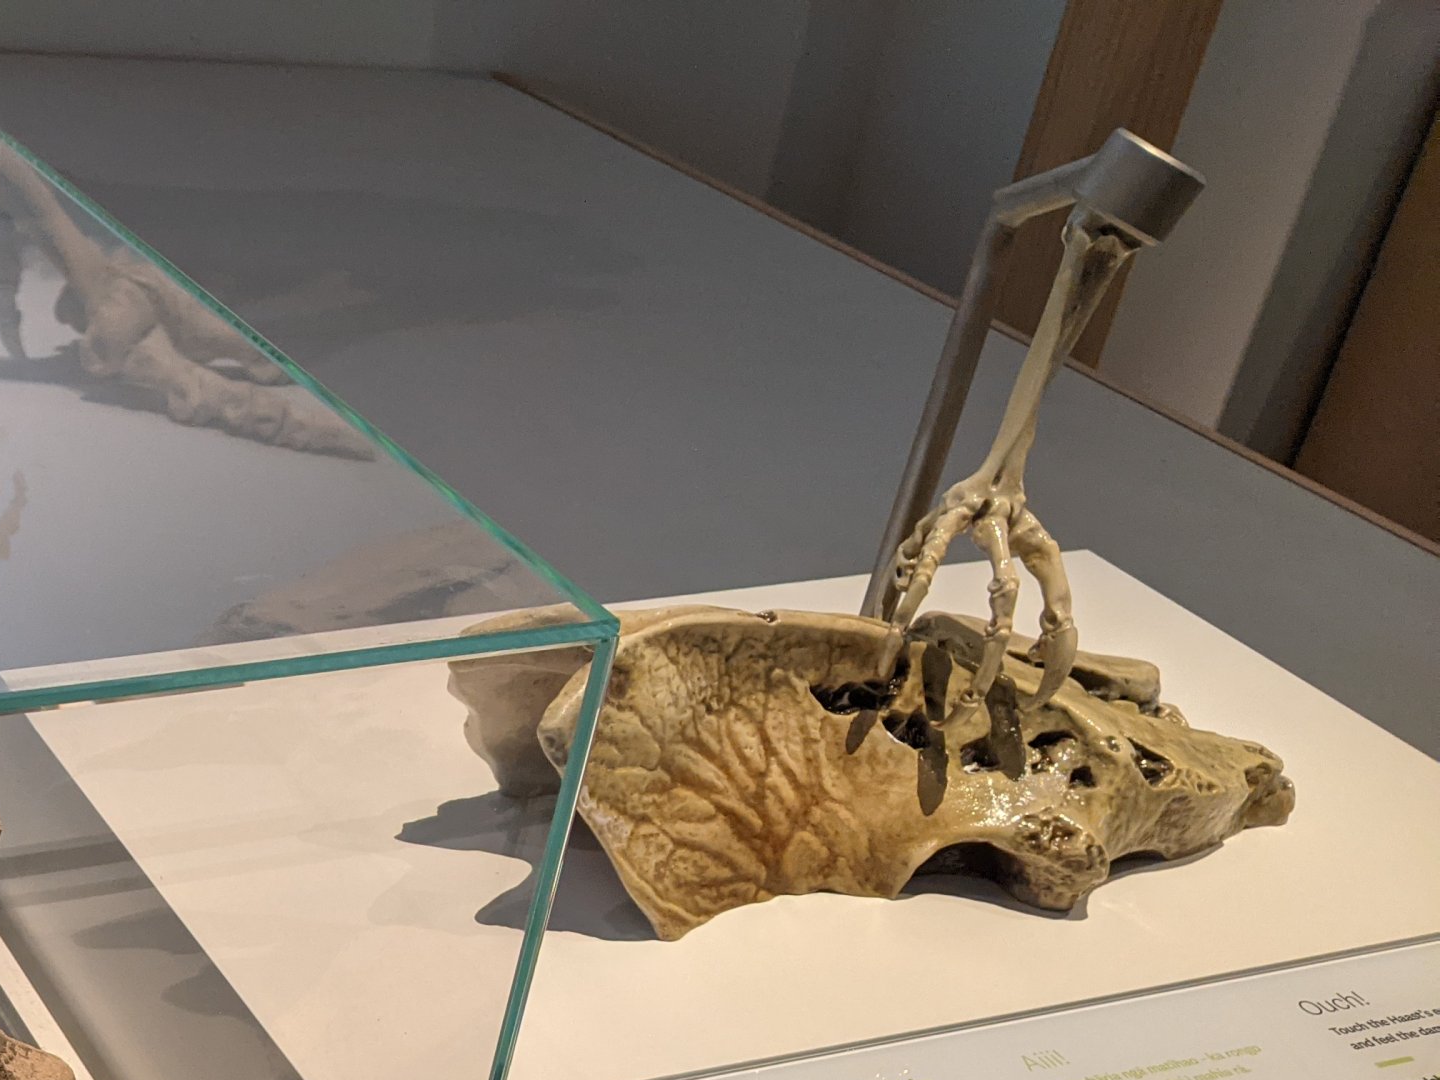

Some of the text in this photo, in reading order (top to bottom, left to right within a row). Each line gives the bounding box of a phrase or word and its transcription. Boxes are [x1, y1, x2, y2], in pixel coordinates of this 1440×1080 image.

[1298, 990, 1371, 1016] Ouch!
[1328, 1021, 1369, 1036] Touch
[1366, 1016, 1390, 1029] the
[1386, 1009, 1434, 1024] Haast's
[1350, 1037, 1375, 1050] and
[1372, 1033, 1400, 1046] feel
[1396, 1028, 1420, 1040] the
